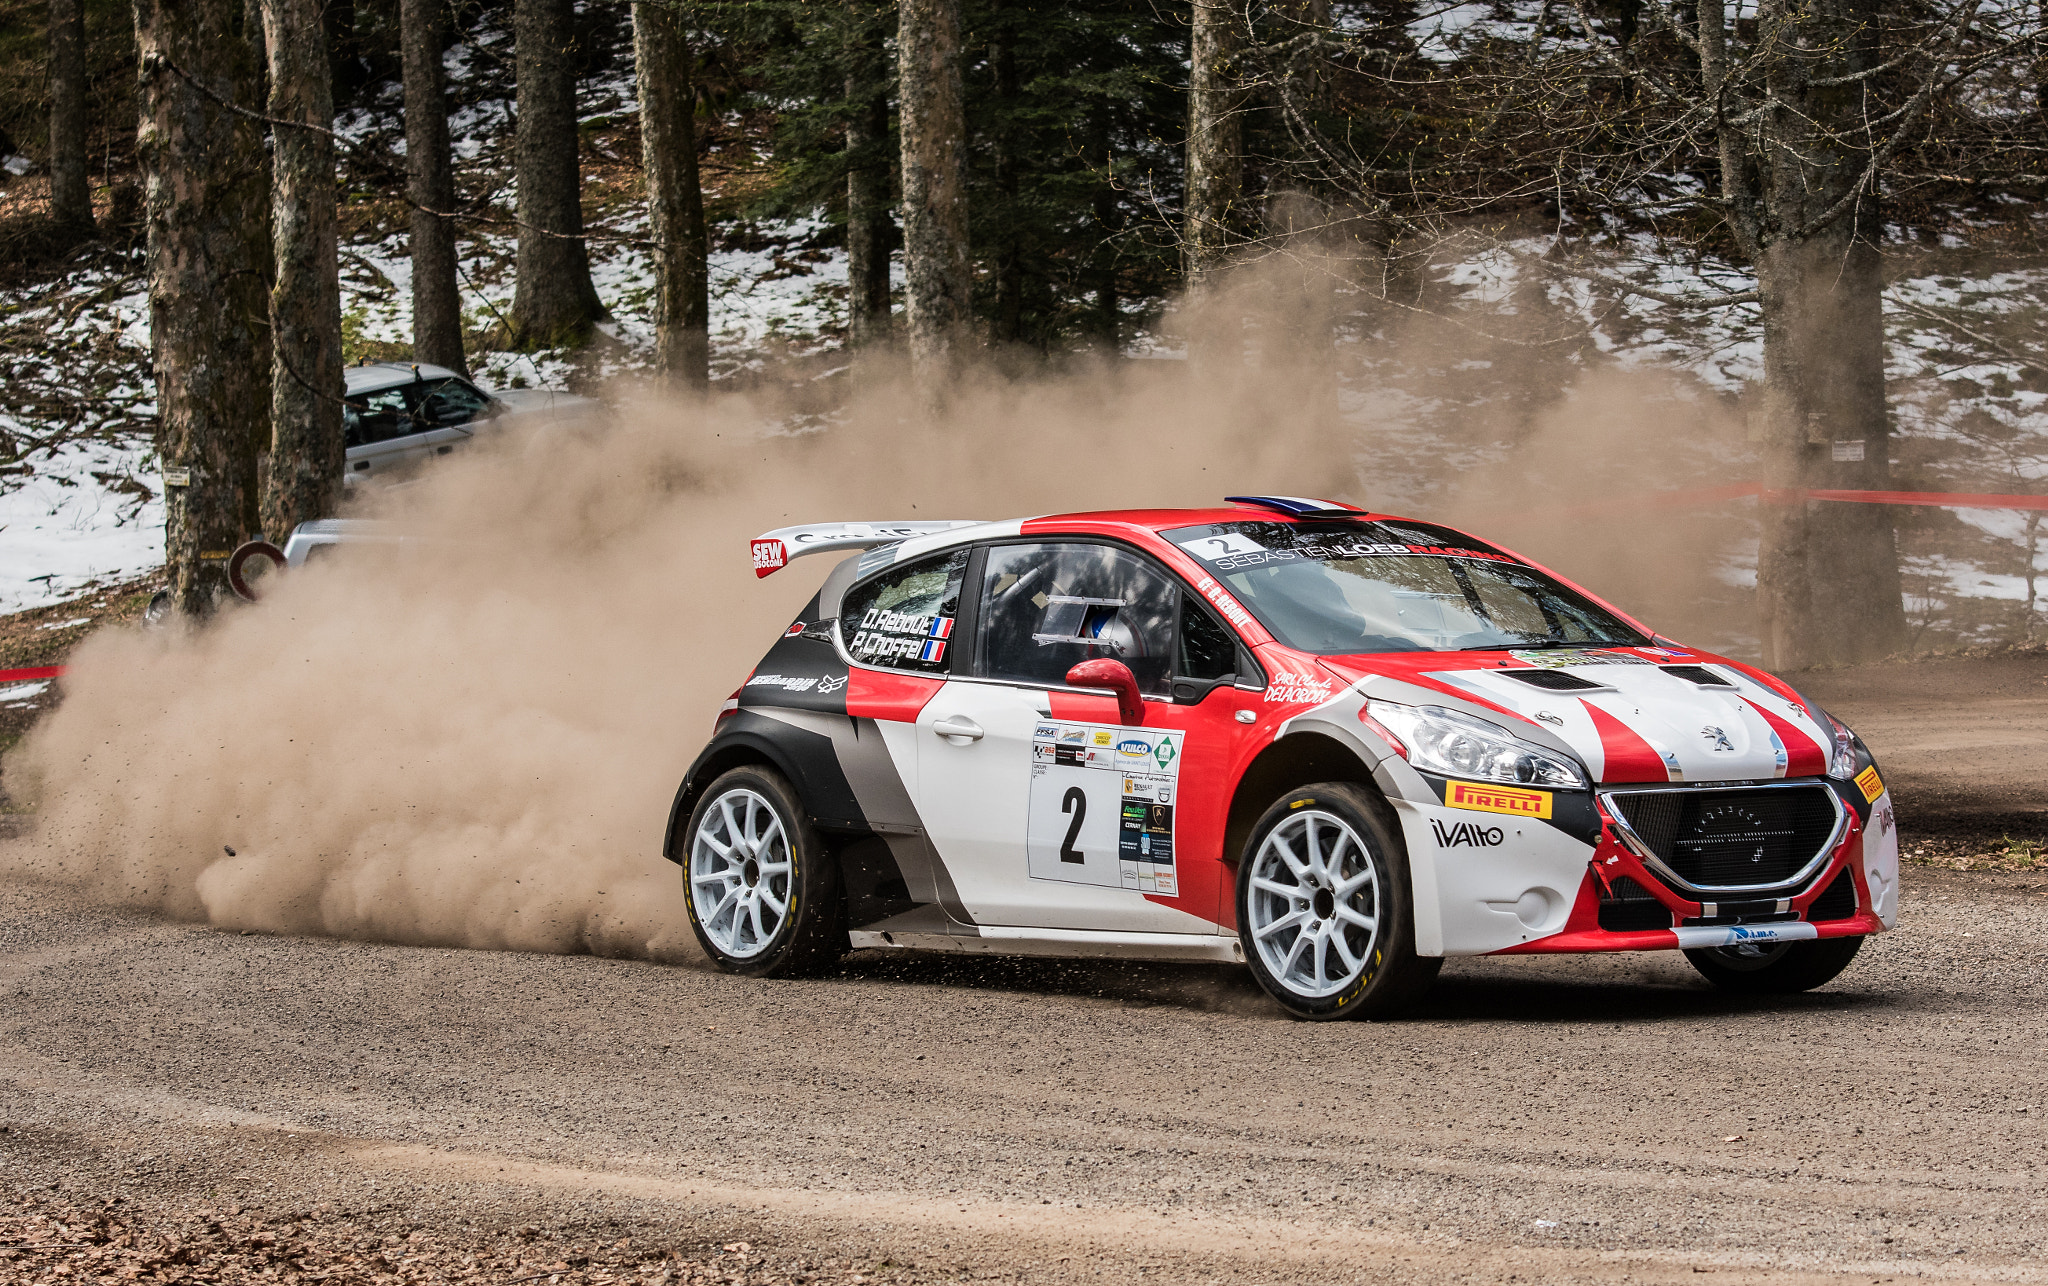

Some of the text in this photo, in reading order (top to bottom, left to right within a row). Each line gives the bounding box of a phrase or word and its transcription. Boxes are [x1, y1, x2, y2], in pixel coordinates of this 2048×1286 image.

[752, 542, 783, 562] SEW
[1208, 538, 1241, 555] 2
[753, 559, 784, 569] USOCOME
[850, 631, 926, 659] P.Choffel
[1272, 672, 1332, 689] SARL Claude
[1264, 686, 1331, 703] DELACROIX
[1120, 743, 1149, 755] VULCO
[1455, 785, 1542, 813] PIRELLI
[1061, 786, 1087, 865] 2
